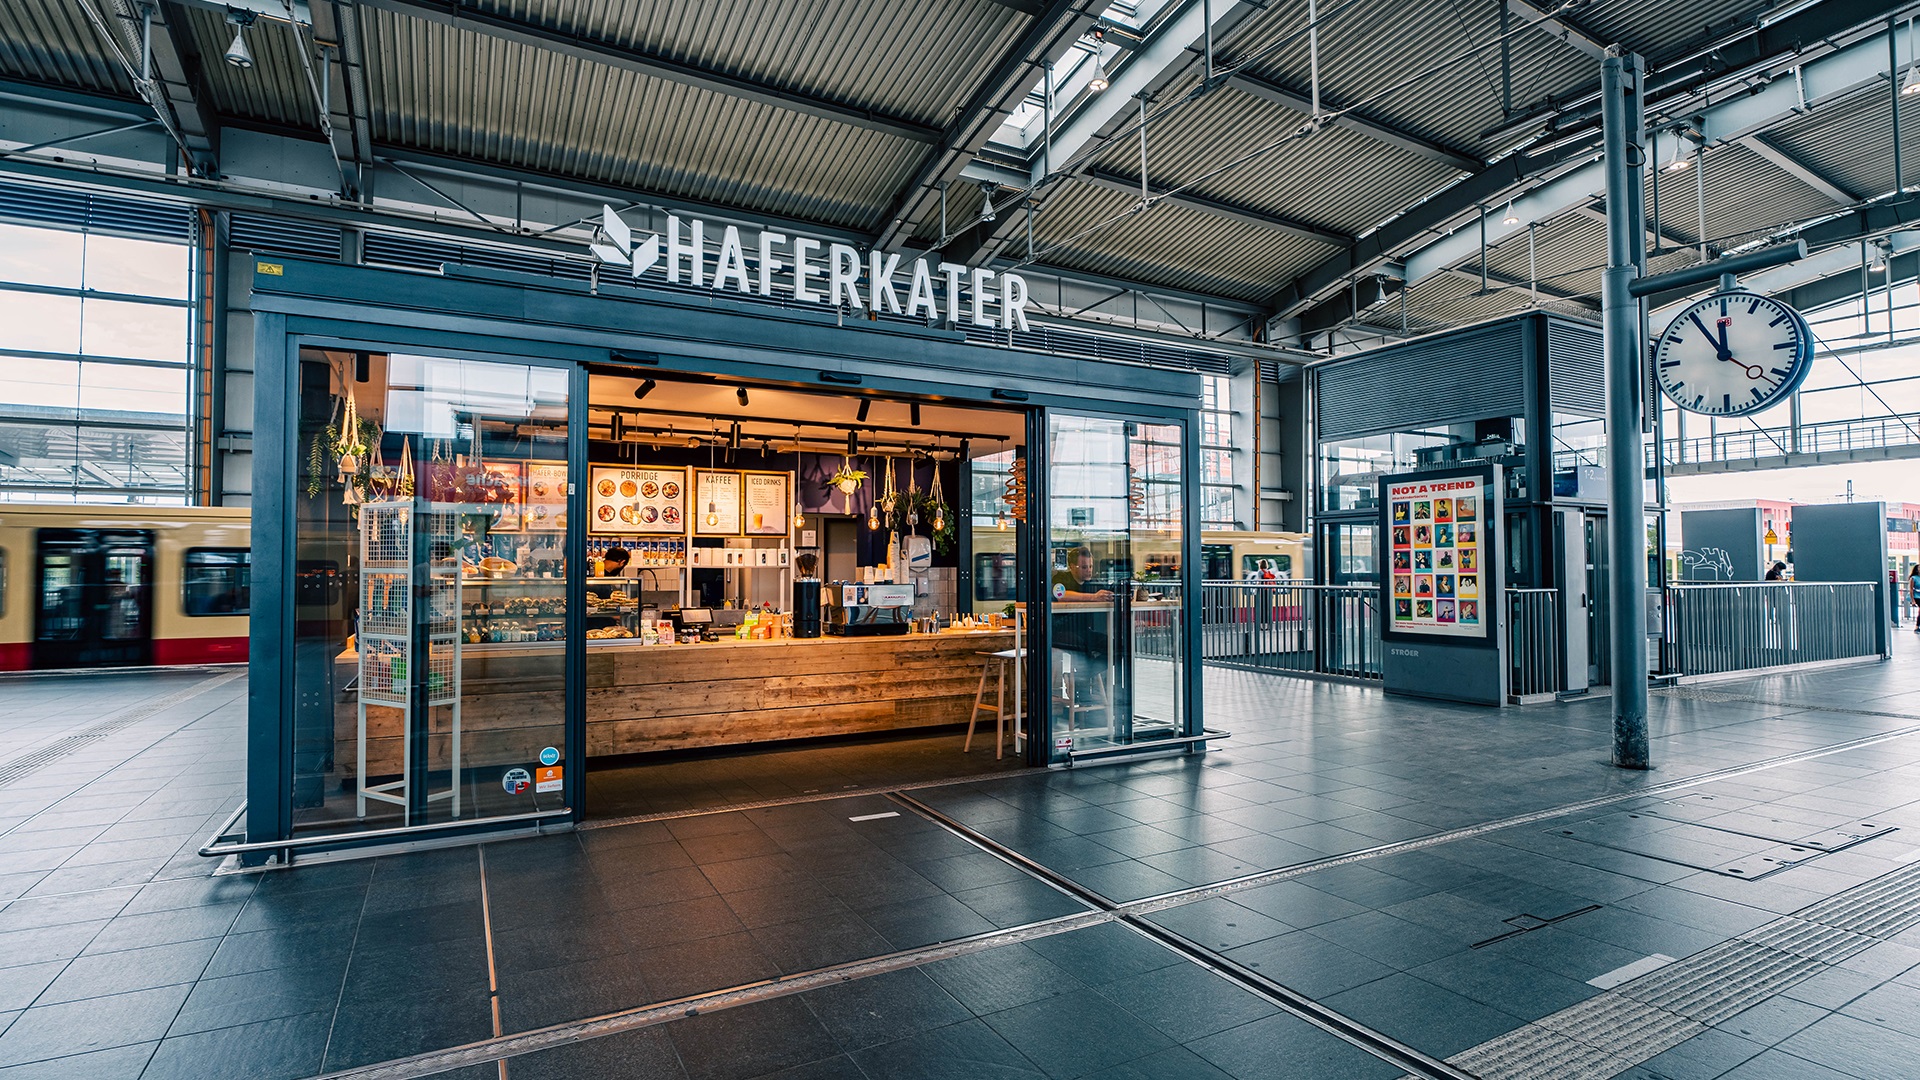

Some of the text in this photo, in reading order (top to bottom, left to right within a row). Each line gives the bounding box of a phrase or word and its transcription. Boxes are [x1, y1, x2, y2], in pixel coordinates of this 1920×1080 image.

[666, 215, 1029, 332] HAFERKATER
[620, 470, 658, 481] PORRIDGE
[705, 475, 732, 485] KAFFEE
[751, 477, 782, 486] ICED DRINKS
[1392, 480, 1475, 495] NOT A TREND
